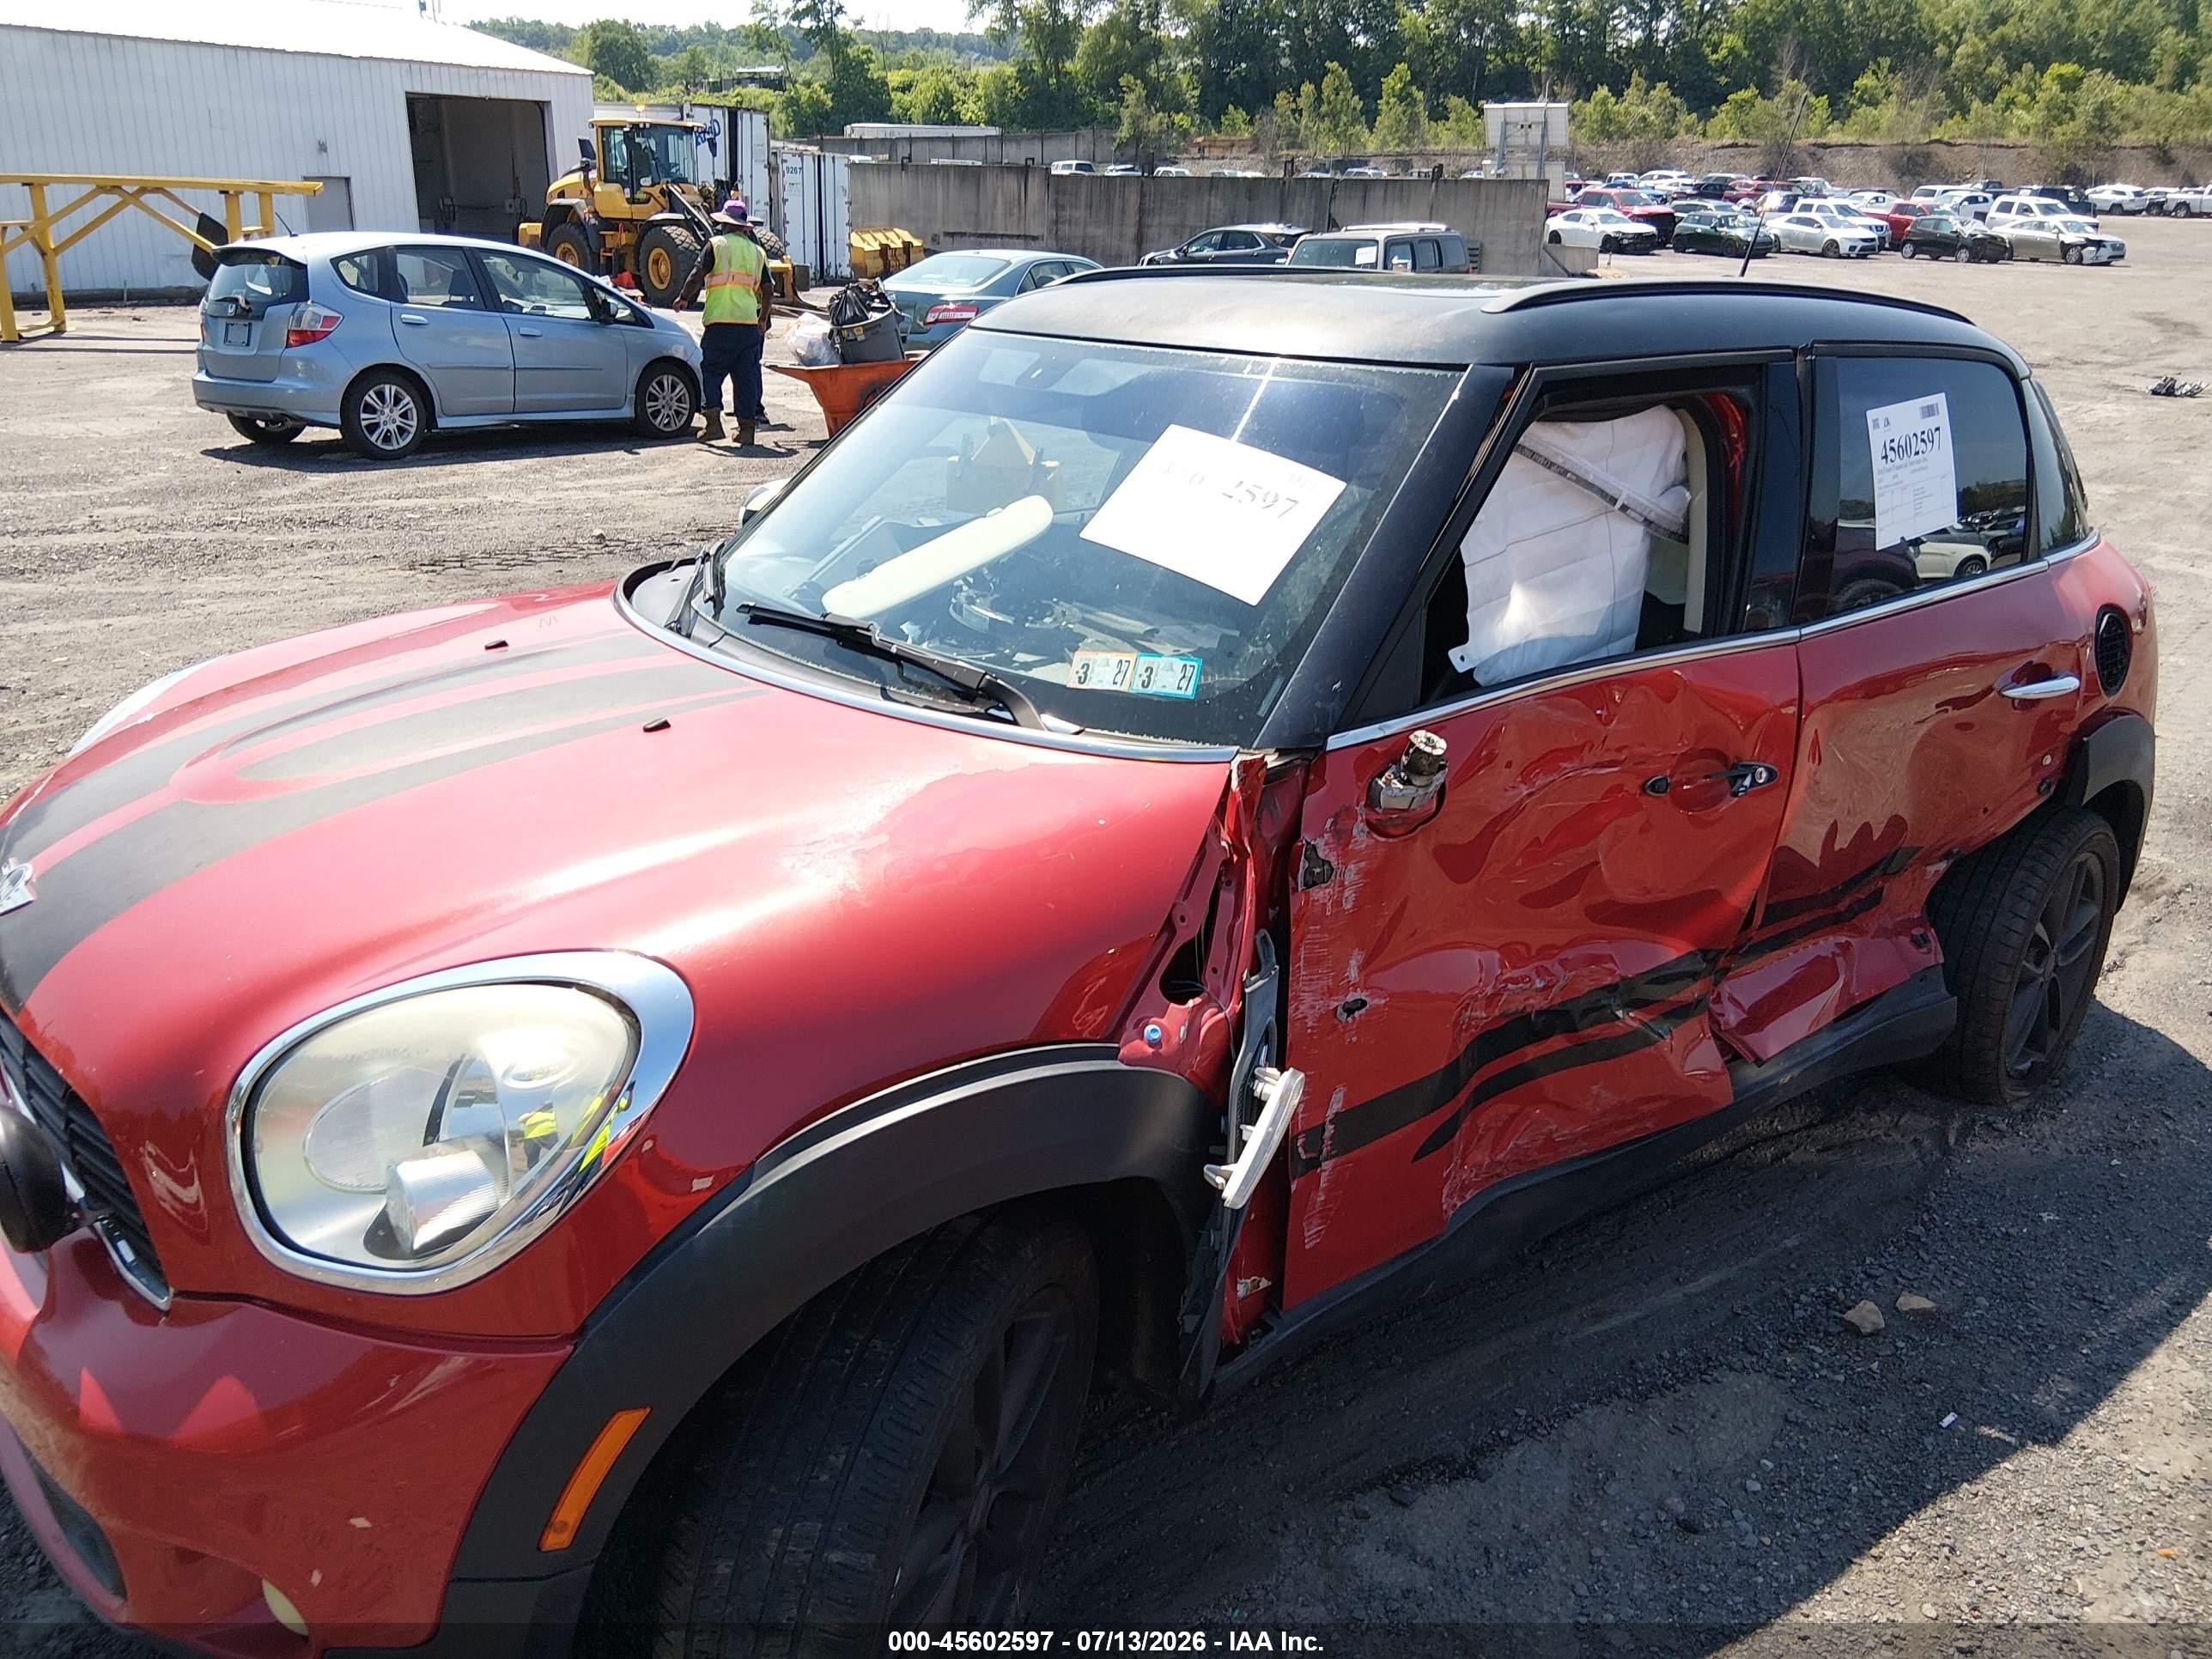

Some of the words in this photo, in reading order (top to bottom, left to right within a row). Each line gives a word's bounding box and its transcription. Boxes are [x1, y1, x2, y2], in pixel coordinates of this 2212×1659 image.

[1881, 426, 1941, 465] 45602597
[1112, 659, 1131, 687] 27
[1176, 663, 1195, 692] 27
